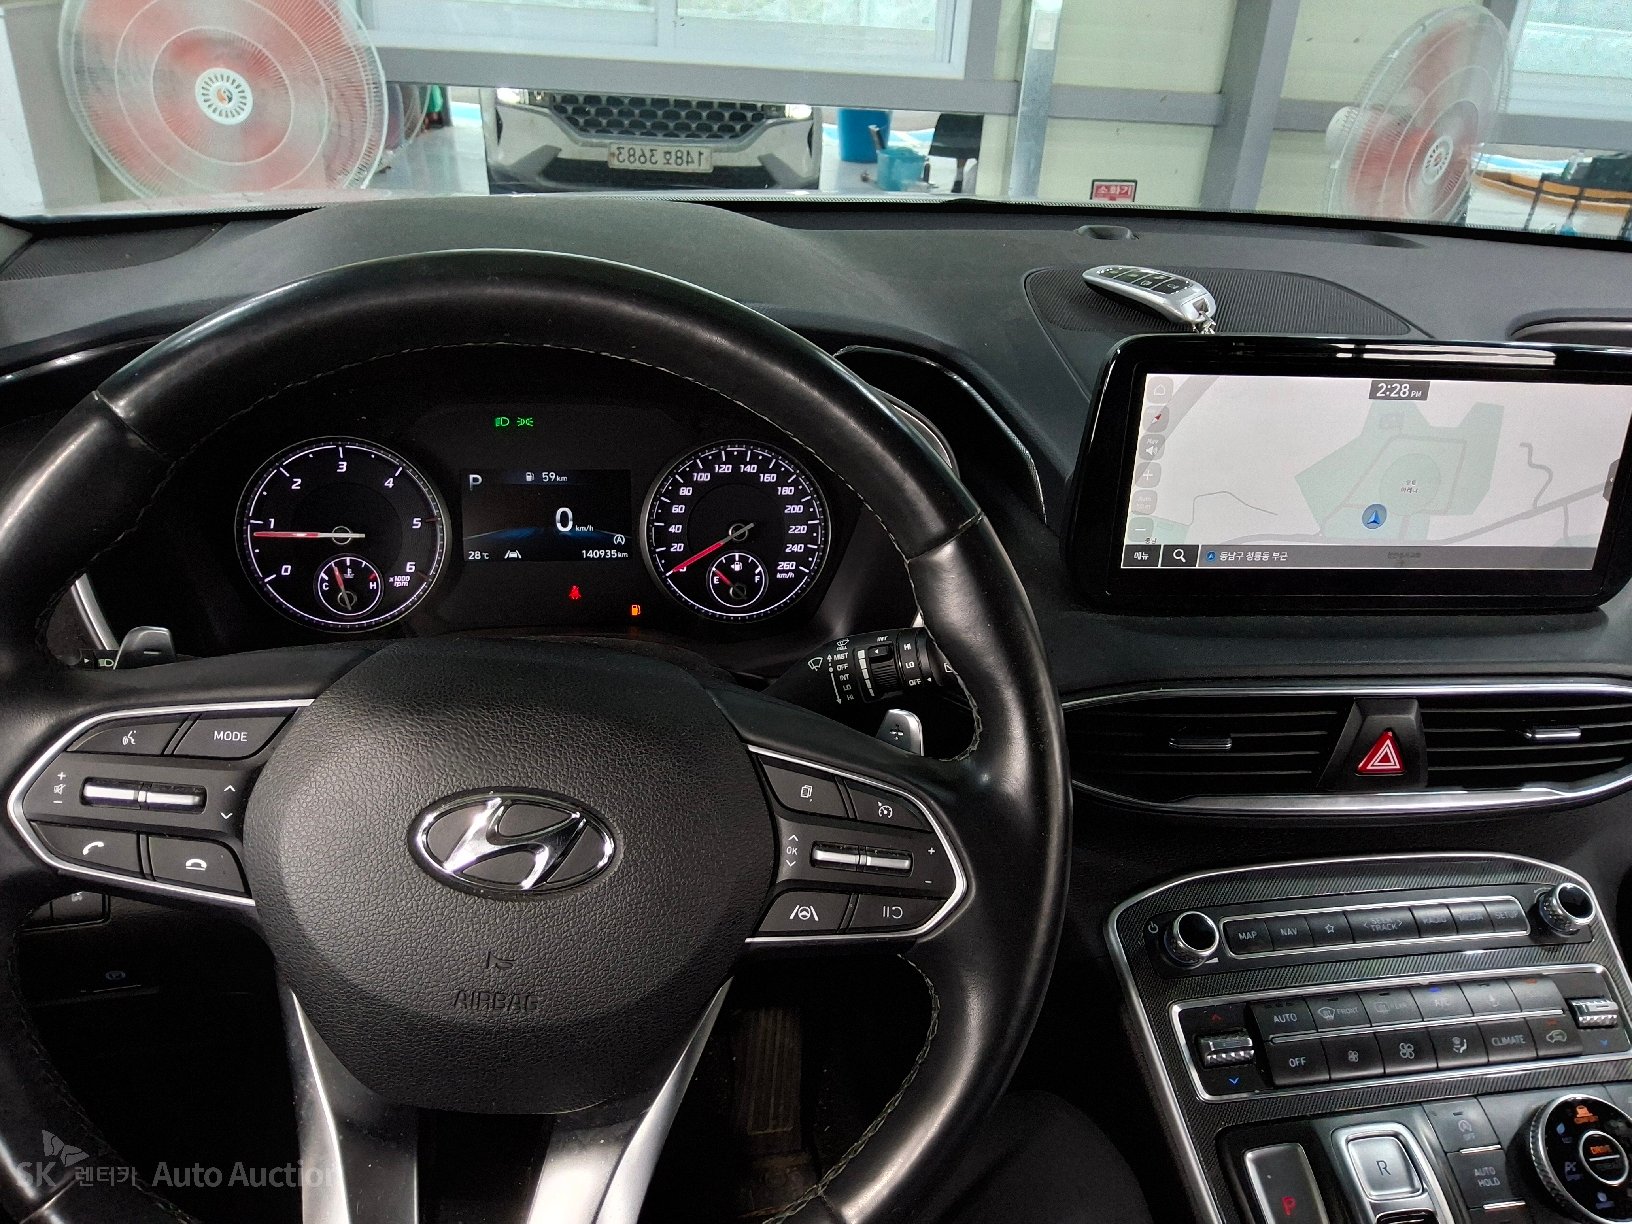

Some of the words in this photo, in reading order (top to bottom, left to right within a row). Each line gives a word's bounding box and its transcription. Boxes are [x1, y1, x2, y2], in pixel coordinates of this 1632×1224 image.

[1096, 184, 1132, 196] 소화기
[1376, 382, 1410, 398] 2:28
[1410, 390, 1422, 398] PM
[336, 461, 347, 473] 3
[714, 464, 733, 473] 120
[739, 464, 758, 473] 140
[692, 472, 711, 481] 100
[759, 473, 777, 482] 160
[291, 478, 302, 490] 2
[384, 477, 395, 489] 4
[469, 473, 483, 491] P
[679, 486, 693, 496] 80
[776, 486, 795, 496] 180
[671, 504, 685, 514] 60
[784, 504, 804, 514] 200
[268, 518, 276, 529] 1
[412, 518, 422, 529] 5
[555, 507, 573, 532] 0
[575, 524, 594, 532] km/h
[668, 525, 682, 534] 40
[788, 525, 808, 535] 220
[670, 543, 685, 552] 20
[785, 544, 805, 553] 240
[1133, 551, 1149, 560] 메뉴
[1219, 551, 1244, 561] 동남구
[1272, 551, 1288, 561] 부근
[281, 565, 292, 576] 0
[406, 562, 416, 573] 6
[776, 561, 796, 571] 260
[754, 576, 761, 584] F
[776, 571, 795, 579] km/h
[713, 576, 720, 585] E
[322, 582, 330, 590] C
[370, 582, 377, 590] H
[903, 643, 912, 651] HI
[834, 652, 849, 661] MIST
[836, 663, 849, 671] OFF
[905, 661, 915, 669] LO
[839, 673, 850, 681] INT
[908, 678, 922, 687] OFF
[213, 730, 248, 742] MODE
[786, 846, 798, 856] OK
[1495, 911, 1518, 920] SETUP
[1280, 927, 1297, 936] NAV
[1370, 924, 1397, 932] TRACK
[1238, 932, 1257, 941] MAP
[454, 989, 539, 1012] AIRBAG
[1273, 1013, 1297, 1023] AUTO
[1491, 1035, 1526, 1046] CLIMATE
[1289, 1057, 1306, 1067] OFF
[1377, 1160, 1392, 1176] R
[1474, 1166, 1496, 1176] AUTO
[1477, 1177, 1501, 1188] HOLD
[1282, 1196, 1296, 1216] P
